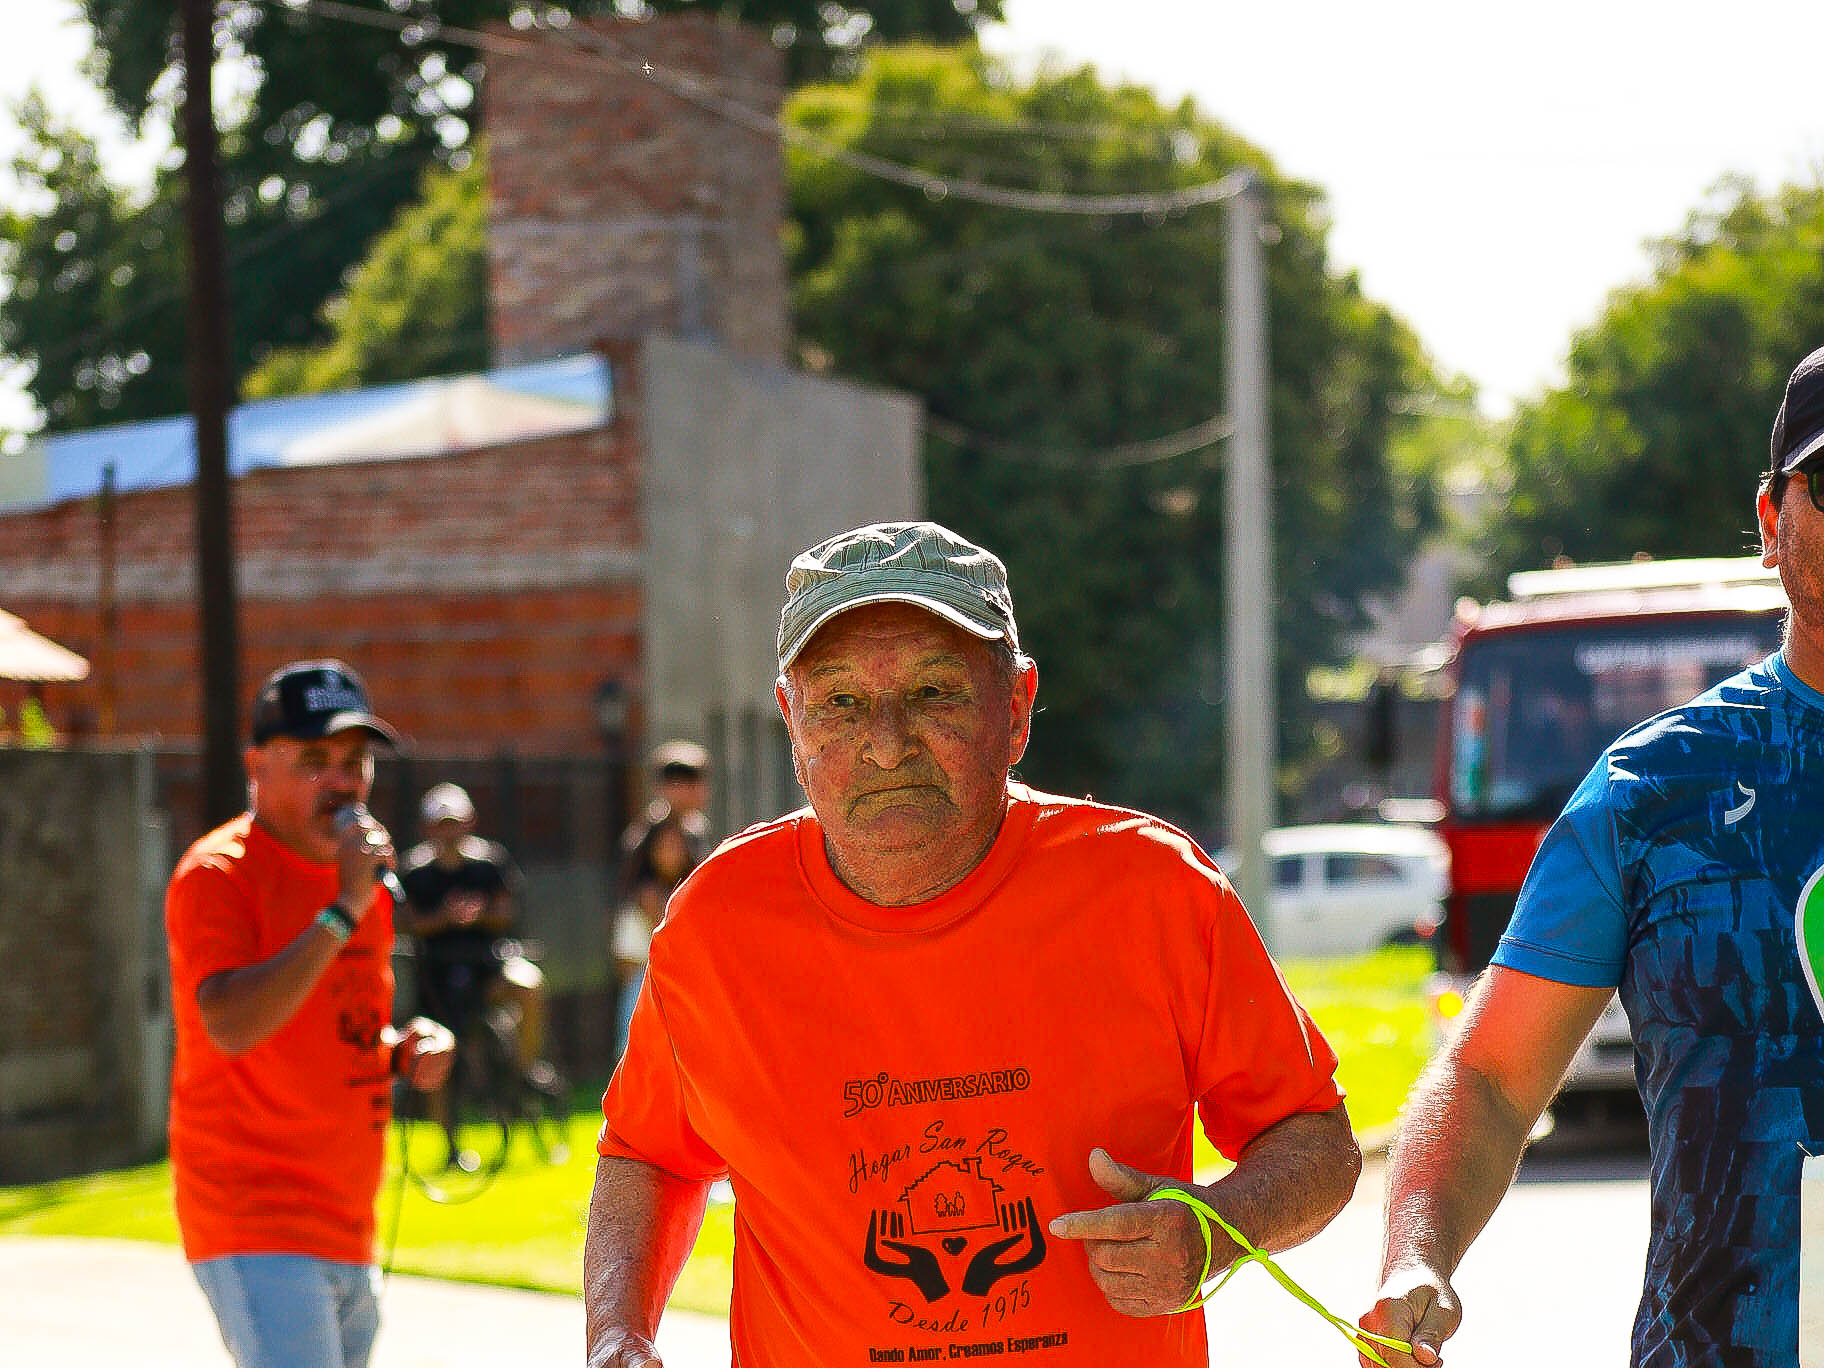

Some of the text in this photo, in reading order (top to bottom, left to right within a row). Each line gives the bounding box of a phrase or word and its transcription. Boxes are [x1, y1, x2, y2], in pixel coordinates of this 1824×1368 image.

[888, 1068, 1031, 1107] ANIVERSARIO
[849, 1120, 1046, 1194] Hogar San Roque
[888, 1279, 1031, 1332] Desde 1975
[868, 1347, 905, 1363] Dando
[949, 1340, 1005, 1359] Creamos
[1007, 1331, 1069, 1354] Esperanza
